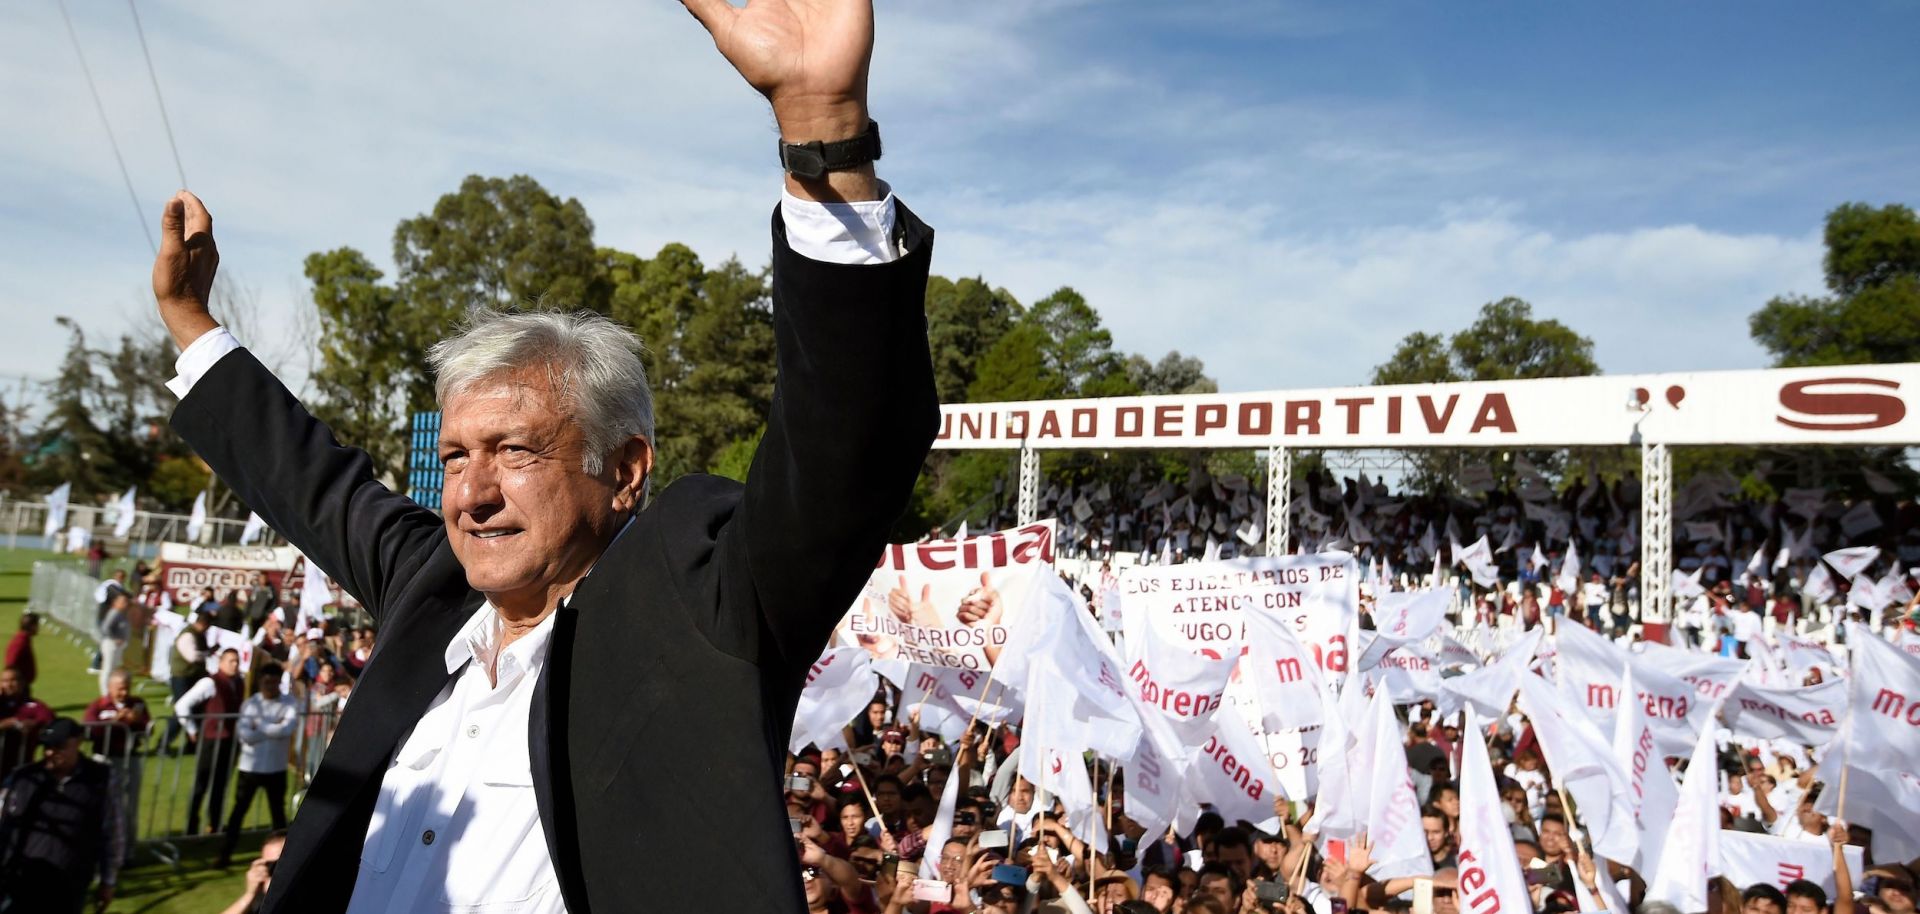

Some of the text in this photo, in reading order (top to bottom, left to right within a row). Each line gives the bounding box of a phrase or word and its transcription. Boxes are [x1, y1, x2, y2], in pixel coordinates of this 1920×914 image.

[937, 408, 1098, 440] UNIDAD
[1115, 393, 1518, 439] DEPORTIVA
[876, 524, 1056, 571] rena
[1128, 578, 1161, 594] OS
[1320, 564, 1344, 582] DE
[1264, 591, 1302, 609] CON
[851, 614, 1008, 646] EJIDATARIOS D
[1174, 622, 1232, 641] UGO
[896, 645, 980, 670] ATENCO
[1588, 683, 1688, 718] mena
[1203, 735, 1264, 800] orena
